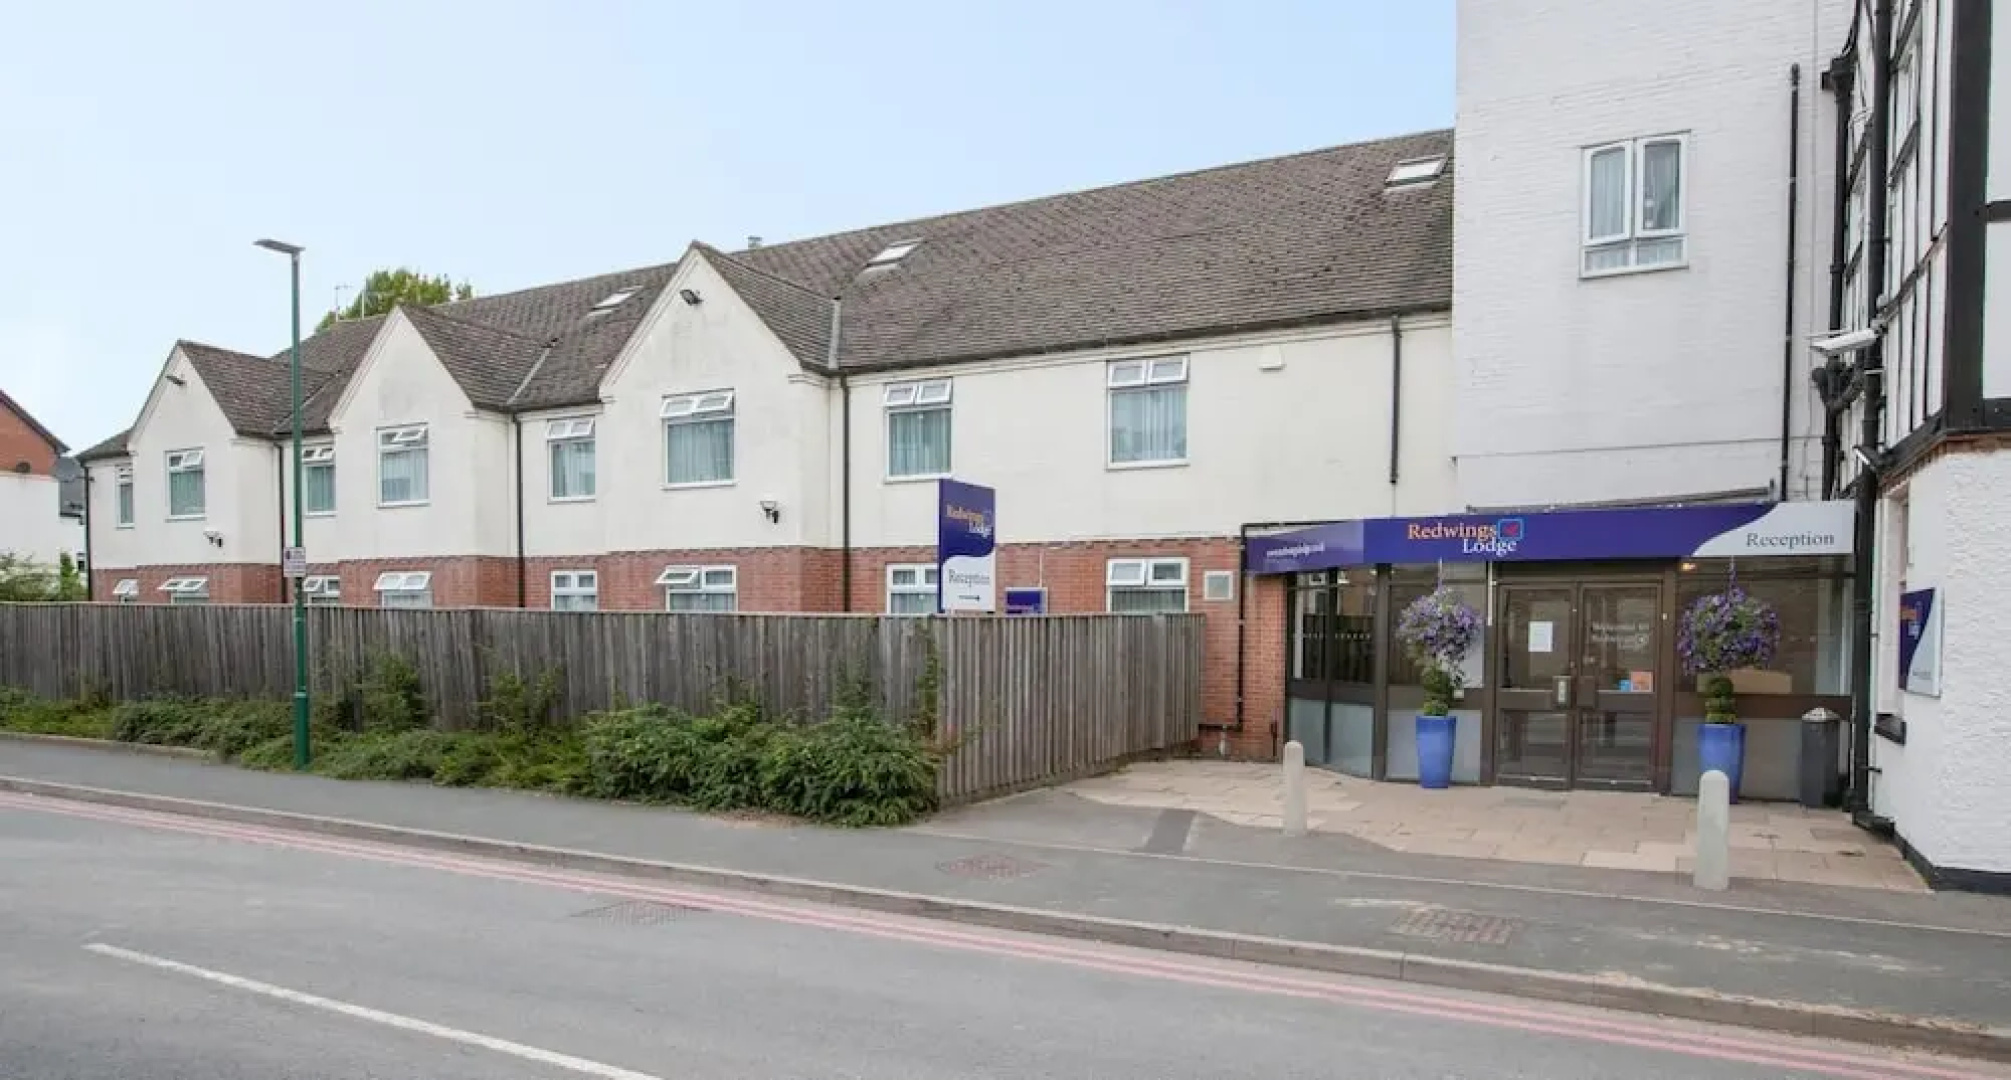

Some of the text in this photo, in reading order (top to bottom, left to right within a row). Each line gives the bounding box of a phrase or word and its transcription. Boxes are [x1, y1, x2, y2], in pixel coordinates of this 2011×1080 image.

[1407, 522, 1497, 542] Redwings
[1746, 530, 1834, 550] Reception
[1463, 538, 1517, 557] Lodge
[948, 568, 990, 587] Reception
